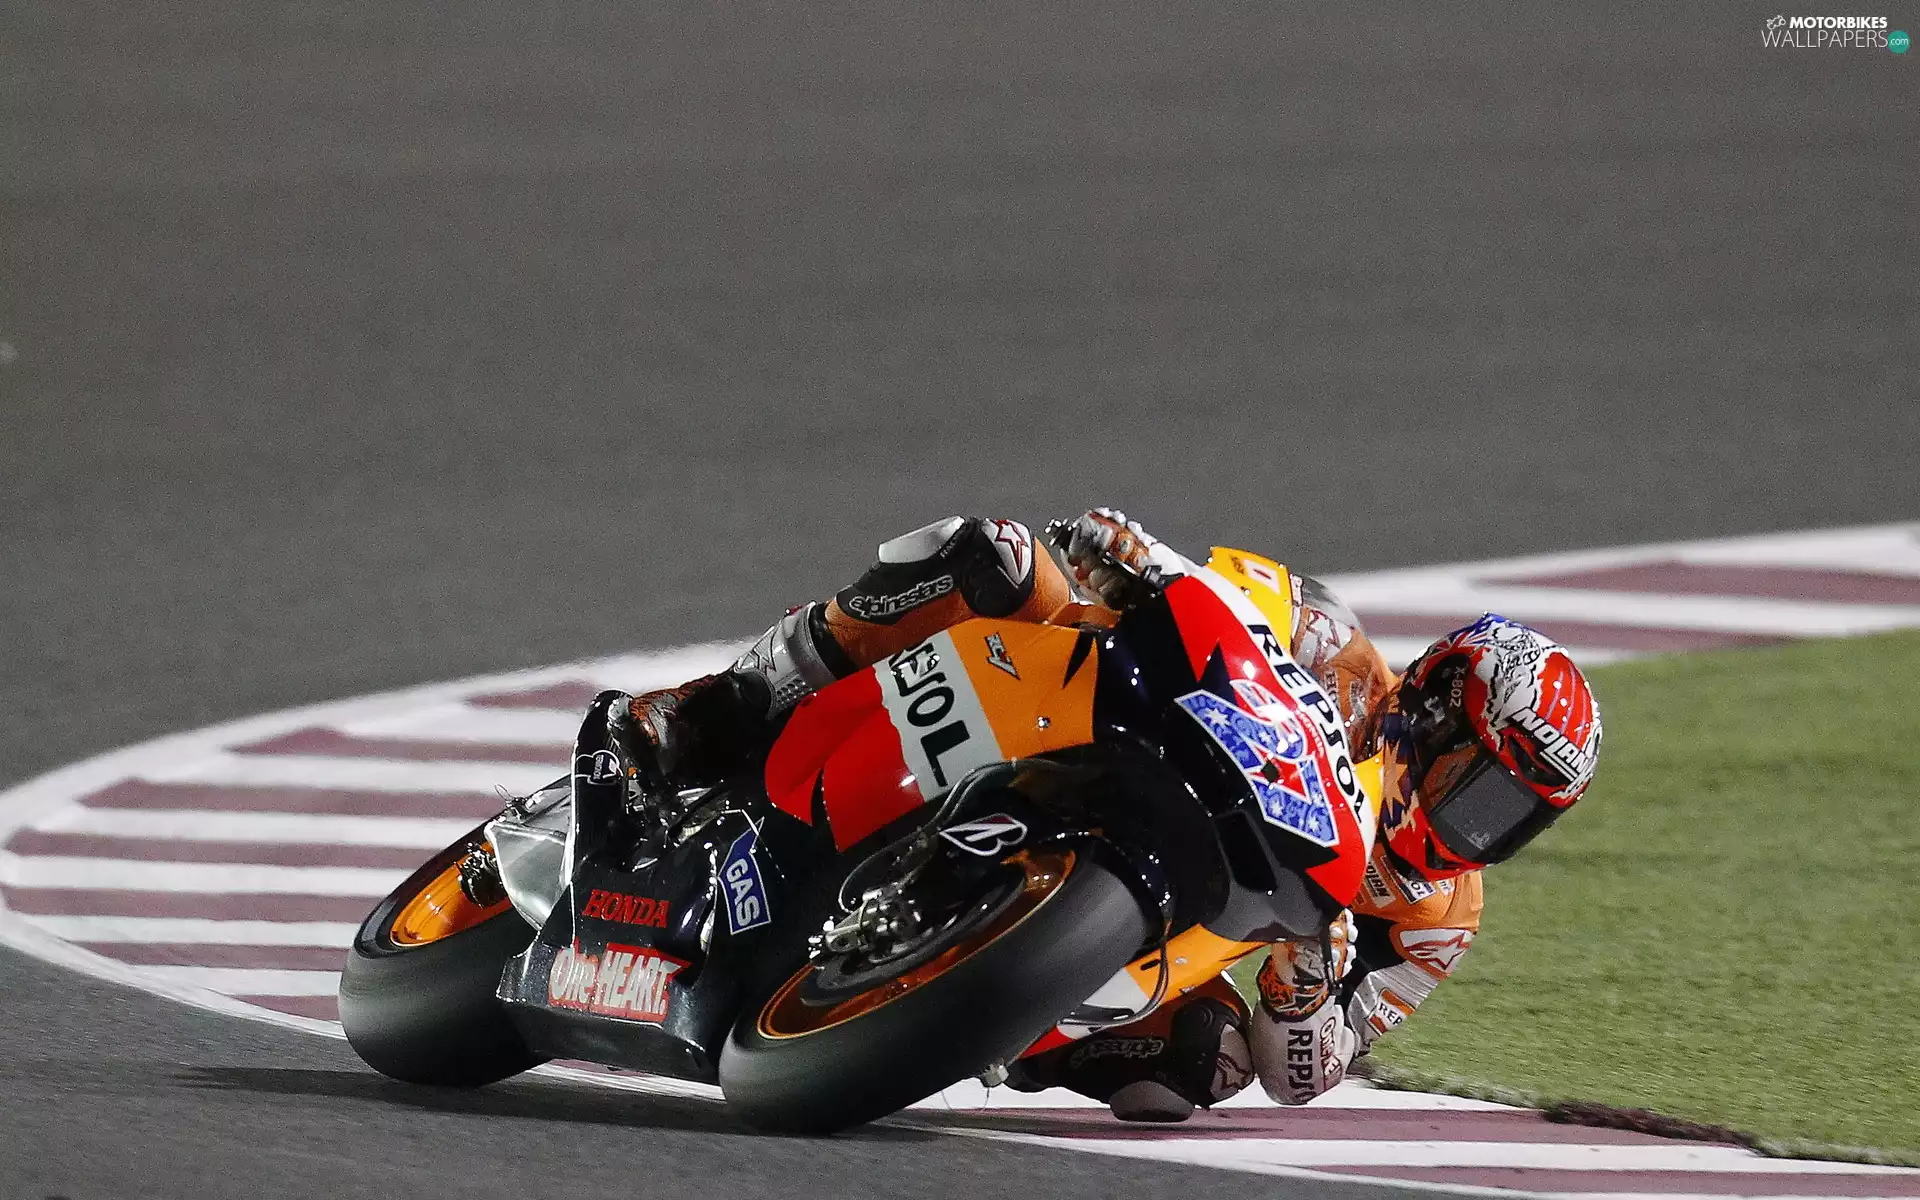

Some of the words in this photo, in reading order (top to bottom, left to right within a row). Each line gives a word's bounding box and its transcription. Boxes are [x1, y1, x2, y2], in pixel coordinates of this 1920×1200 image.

[1247, 624, 1365, 824] REPSOL
[1512, 706, 1591, 782] NOLAN
[582, 888, 671, 928] HONDA
[725, 857, 762, 928] GAS
[551, 948, 599, 1001] One
[1378, 1002, 1403, 1026] REP
